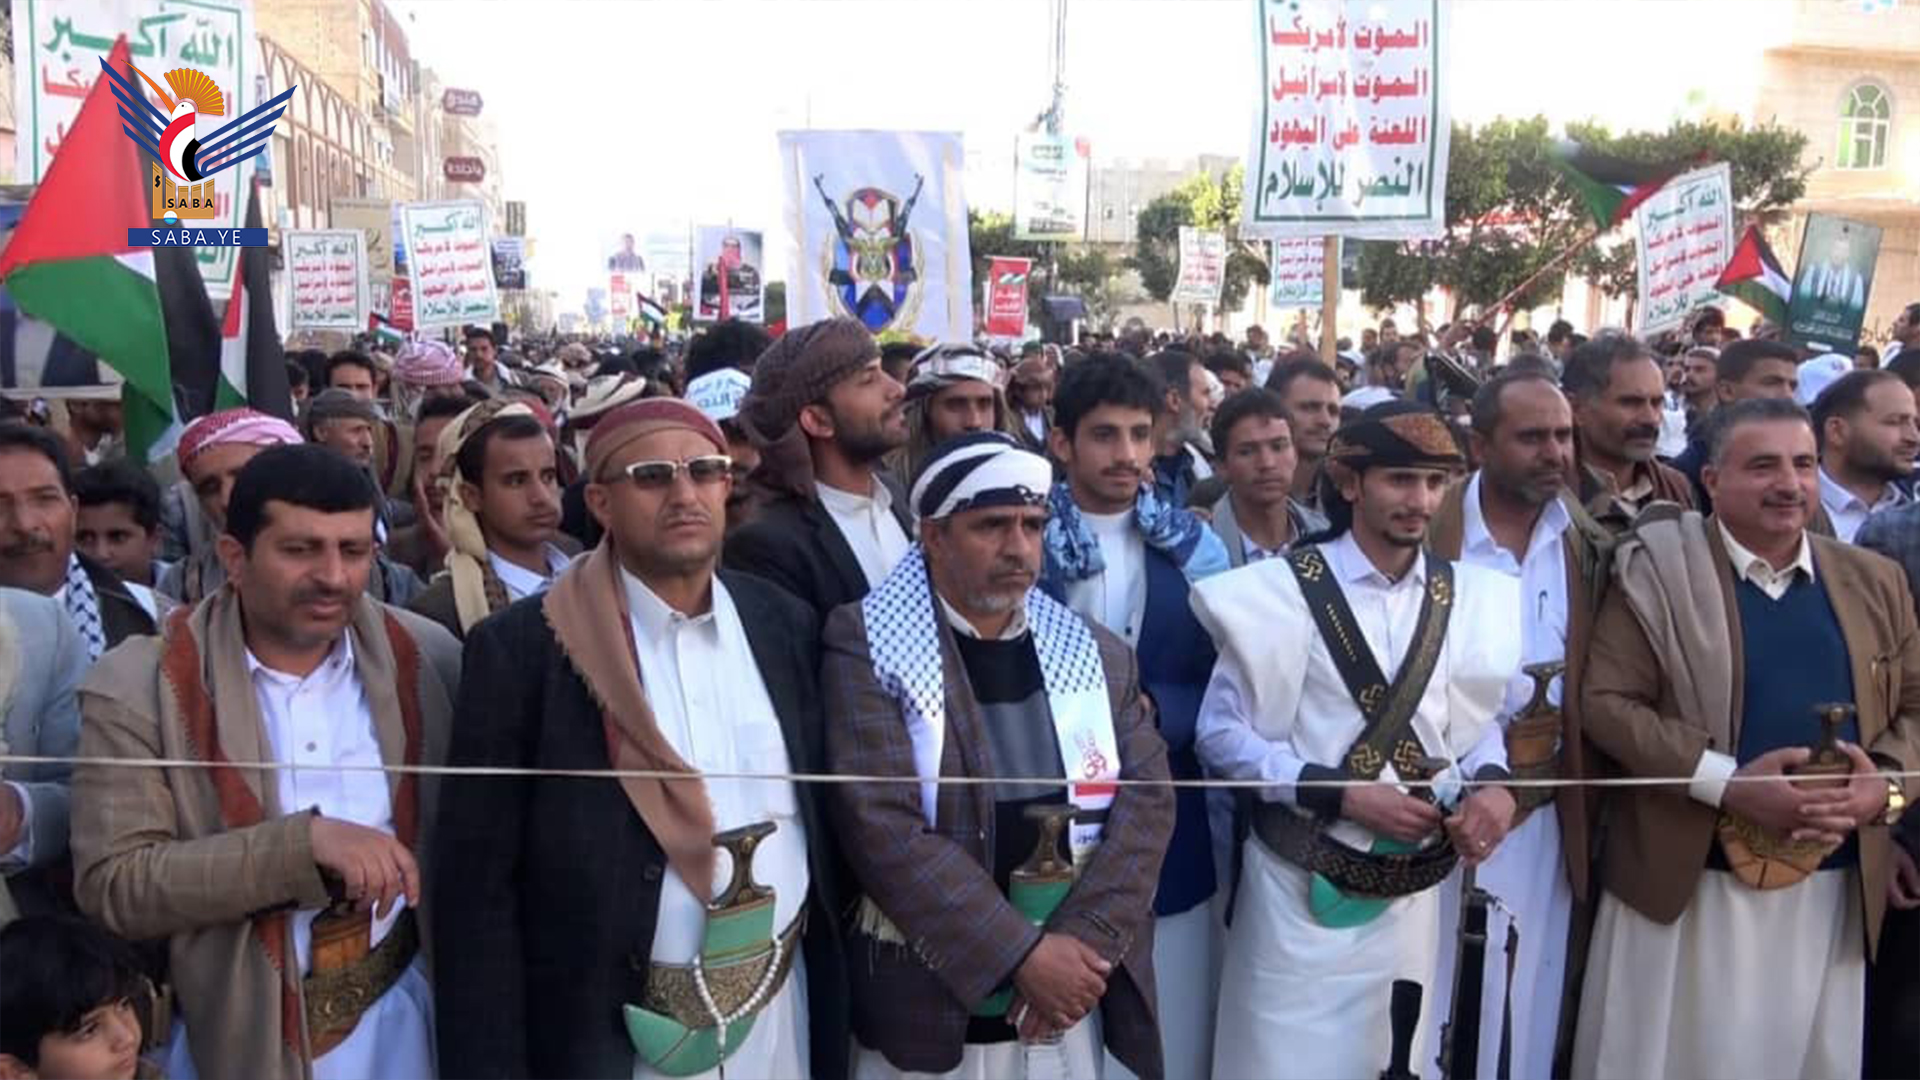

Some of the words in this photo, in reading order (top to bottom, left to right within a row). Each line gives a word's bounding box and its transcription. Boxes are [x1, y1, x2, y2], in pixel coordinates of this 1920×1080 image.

[180, 19, 233, 67] الله
[1354, 20, 1428, 55] الموت
[1353, 67, 1428, 103] الموت
[1270, 115, 1325, 150] اليهود
[1333, 117, 1361, 151] على
[1369, 115, 1426, 145] اللعنة
[1265, 159, 1345, 212] للإسلام
[1352, 156, 1423, 207] النصر
